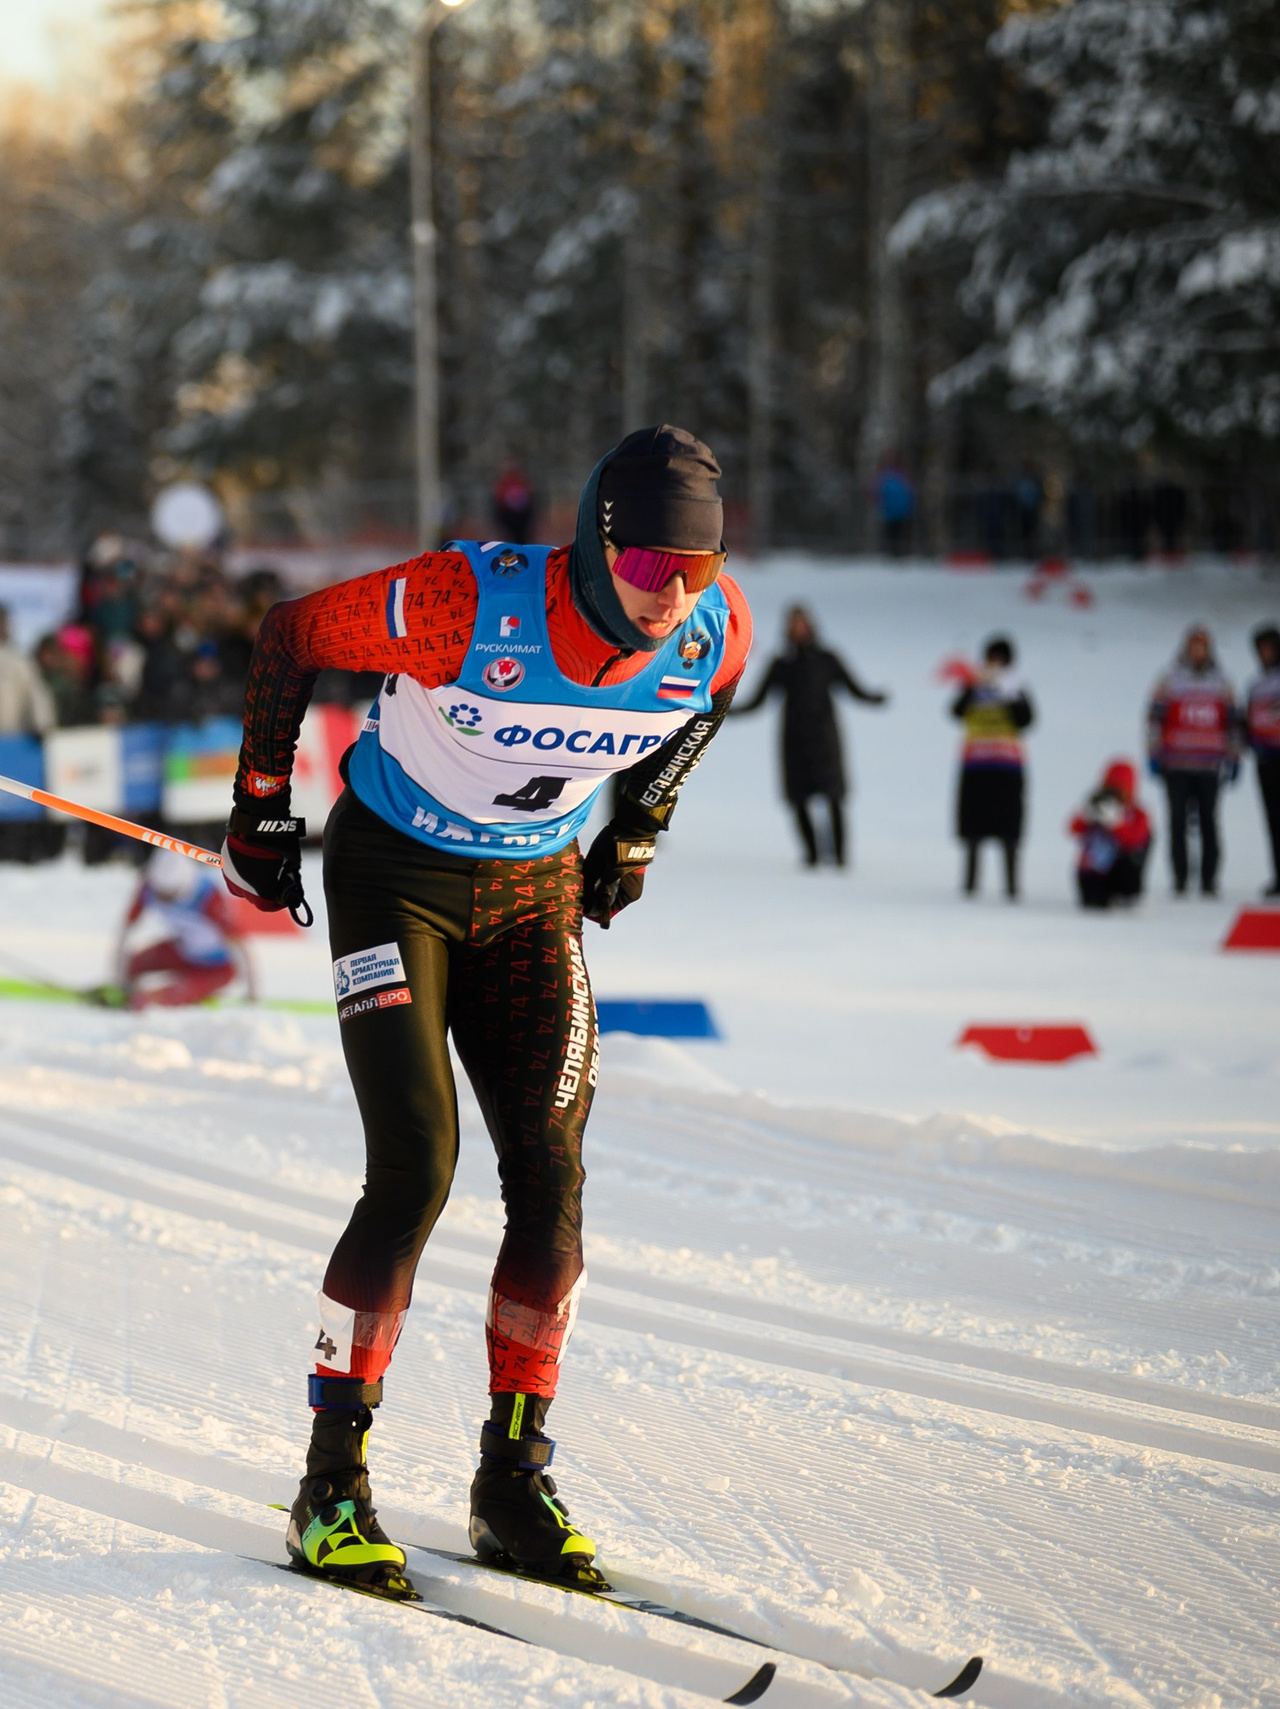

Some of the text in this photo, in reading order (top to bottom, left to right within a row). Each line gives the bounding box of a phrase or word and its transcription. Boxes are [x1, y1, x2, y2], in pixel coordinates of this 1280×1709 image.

[439, 558, 462, 574] 74
[407, 592, 424, 611] 74
[412, 638, 435, 652] 74
[437, 630, 465, 650] 74
[475, 643, 542, 654] РУСКЛИМАТ
[492, 775, 572, 812] 4
[350, 953, 377, 968] ПЕРВАЯ
[542, 947, 557, 963] 74
[351, 958, 400, 976] АРМАТУРНАЯ
[352, 968, 395, 986] КОМПАНИЯ
[554, 936, 590, 1108] ЧЕЛЯБИНСКАЯ
[315, 1328, 337, 1361] 4
